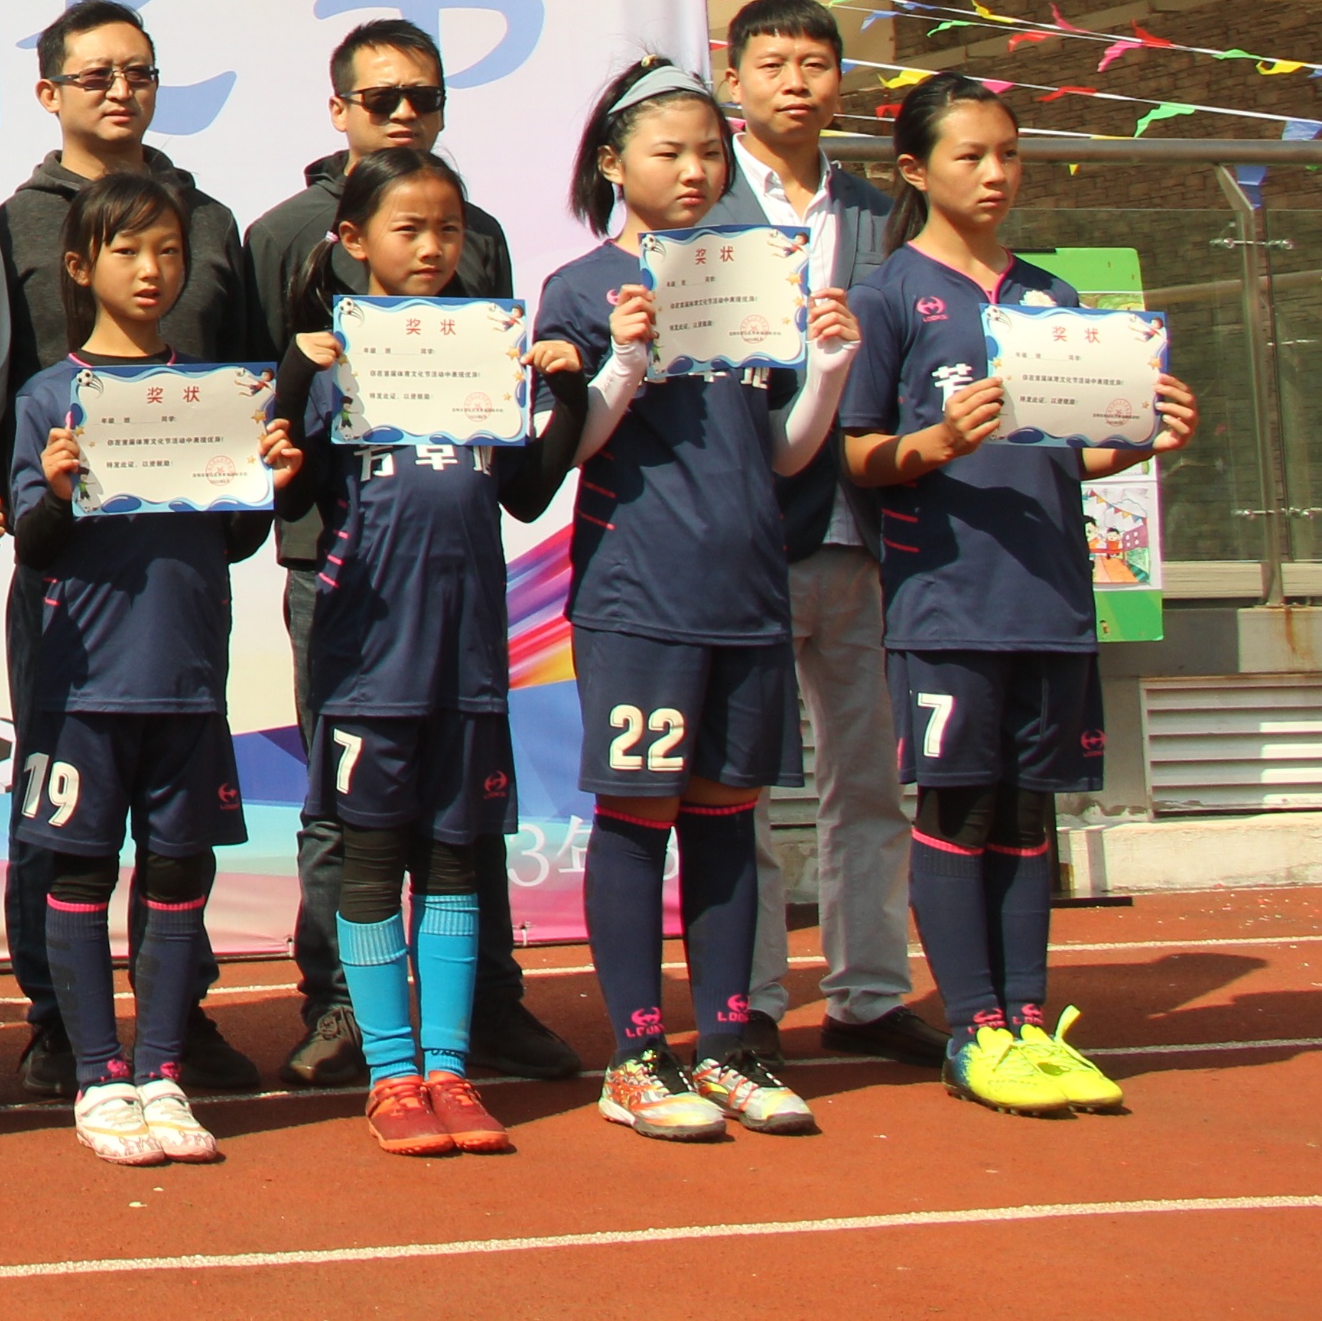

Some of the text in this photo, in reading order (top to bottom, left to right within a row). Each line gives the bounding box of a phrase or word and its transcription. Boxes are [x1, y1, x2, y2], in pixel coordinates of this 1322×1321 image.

[695, 246, 734, 265] 奖状
[406, 319, 456, 335] 奖状
[1052, 326, 1100, 343] 奖状
[147, 387, 200, 403] 奖状
[608, 704, 685, 772] 22
[917, 692, 954, 758] 7
[333, 728, 364, 795] 7
[22, 752, 80, 827] 19
